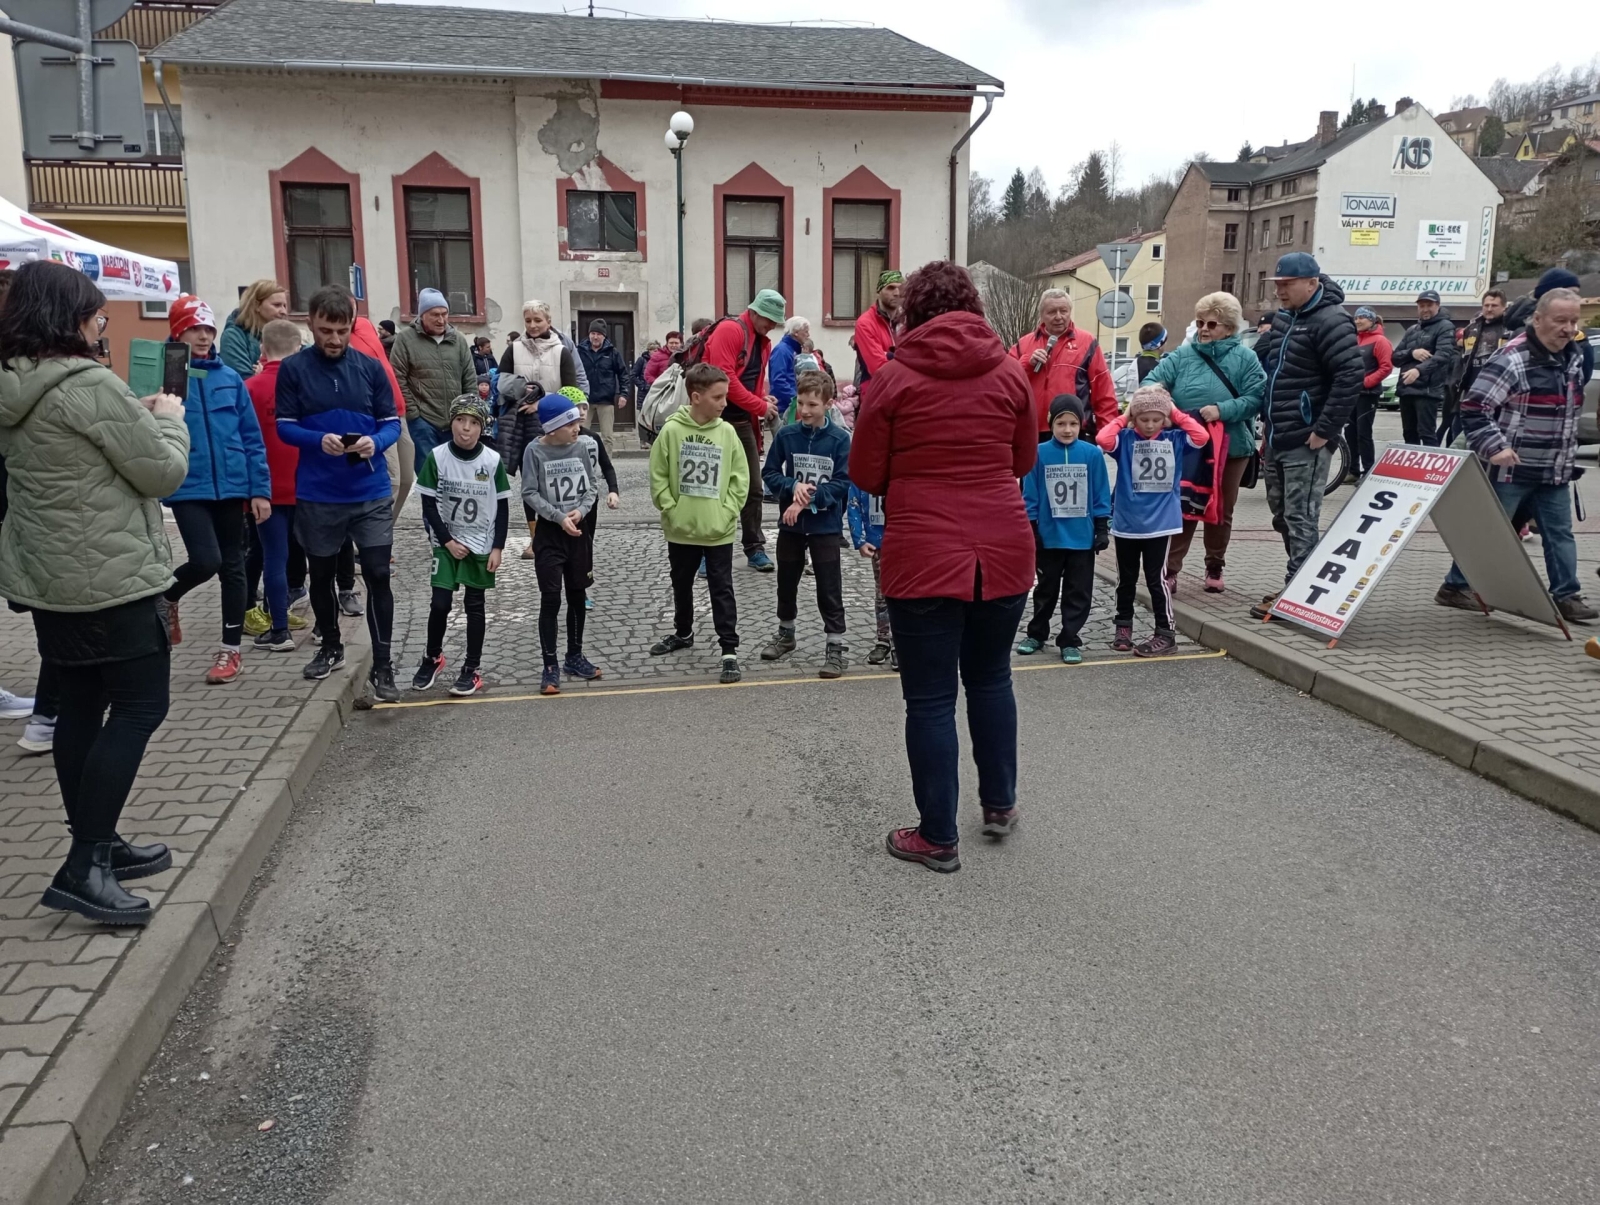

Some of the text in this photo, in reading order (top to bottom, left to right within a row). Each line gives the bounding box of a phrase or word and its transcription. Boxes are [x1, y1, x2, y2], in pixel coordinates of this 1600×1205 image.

[1393, 137, 1433, 169] AGB
[1343, 195, 1390, 211] TONAVA
[1341, 218, 1395, 229] VÁHY ÚPICE
[1480, 210, 1490, 275] JÍDELNA
[101, 255, 129, 270] MARATON
[1381, 277, 1469, 292] OBČERSTVENÍ
[682, 458, 719, 487] 231
[1139, 456, 1167, 481] 28
[1382, 449, 1461, 473] MARATON
[549, 475, 587, 503] 124
[1424, 473, 1446, 482] stav
[1054, 480, 1077, 505] 91
[448, 495, 478, 523] 79
[1305, 490, 1398, 606] START
[1278, 602, 1341, 629] www.maratonstav.cz
